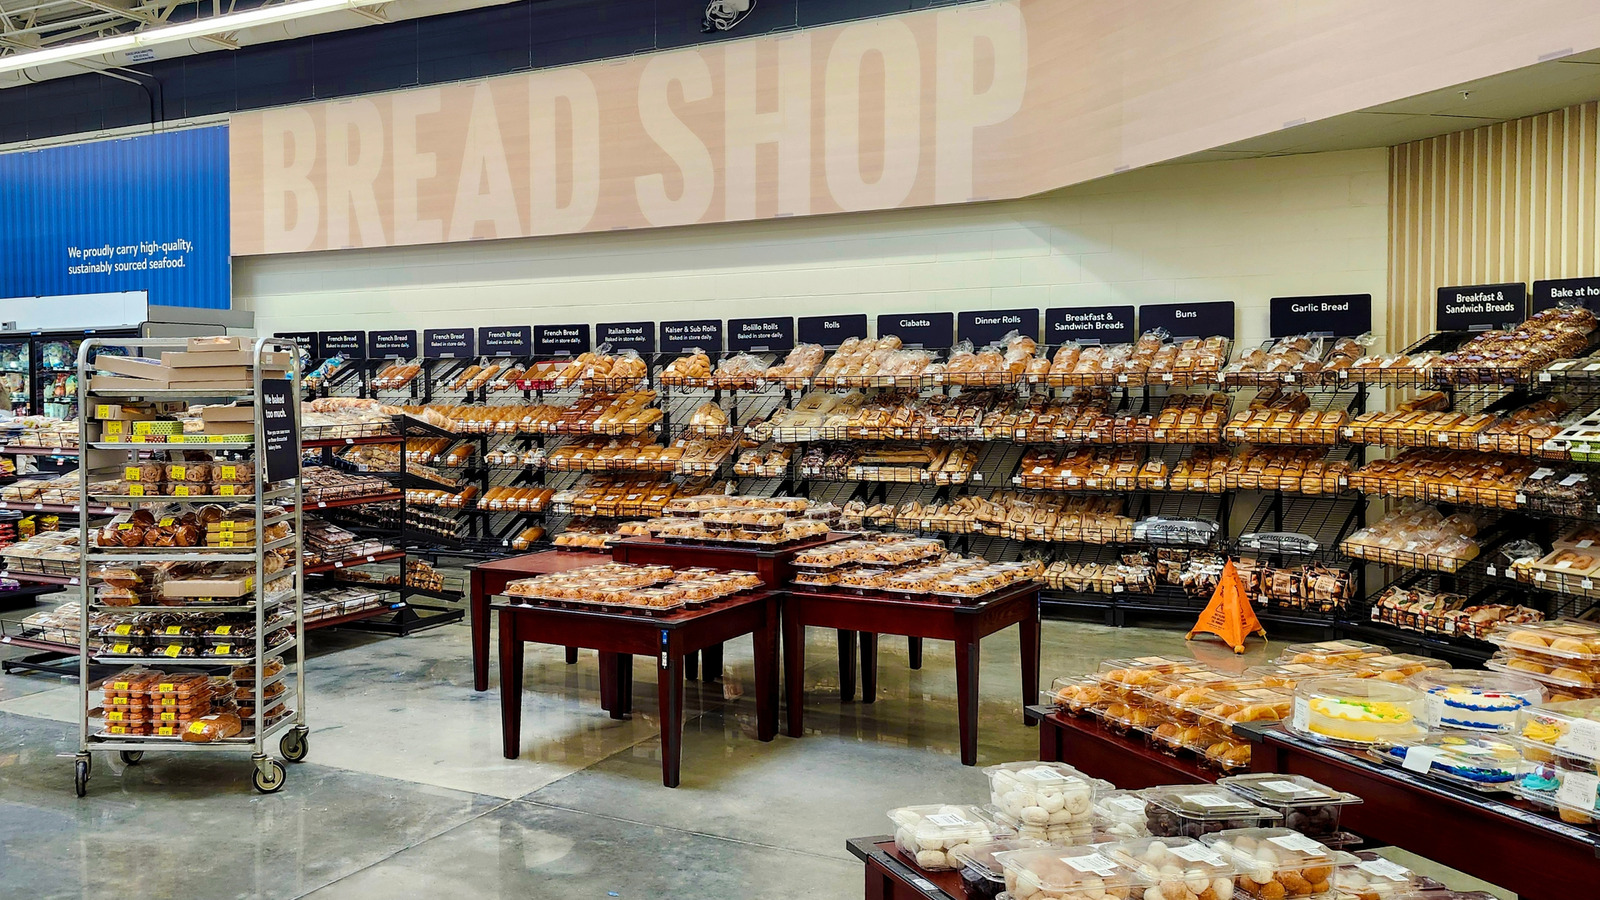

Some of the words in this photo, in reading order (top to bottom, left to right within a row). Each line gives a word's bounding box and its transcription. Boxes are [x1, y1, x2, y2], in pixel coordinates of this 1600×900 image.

[263, 68, 599, 253] BREAD
[635, 2, 1027, 224] SHOP
[68, 246, 81, 258] We
[83, 244, 114, 260] proudly
[116, 245, 138, 257] carry
[140, 238, 193, 256] high-quality,
[68, 260, 112, 275] sustainably
[114, 258, 148, 272] sourced
[149, 256, 186, 269] seafood.
[1456, 292, 1496, 302] Breakfast
[1496, 291, 1504, 301] &
[1550, 288, 1574, 298] Bake
[1574, 287, 1586, 296] at
[1586, 286, 1600, 296] ho
[1291, 304, 1319, 312] Garlic
[1321, 302, 1348, 311] Bread
[1445, 304, 1484, 314] Sandwich
[1486, 302, 1515, 312] Breads
[1065, 313, 1105, 322] Breakfast
[1106, 312, 1114, 320] &
[1175, 310, 1197, 318] Buns
[900, 319, 930, 327] Ciabatta
[975, 316, 1000, 324] Dinner
[1002, 316, 1021, 324] Rolls
[1054, 322, 1094, 331] Sandwich
[1095, 321, 1124, 330] Breads
[264, 394, 271, 404] We
[272, 394, 285, 404] baked
[266, 409, 274, 418] too
[274, 408, 286, 418] much.
